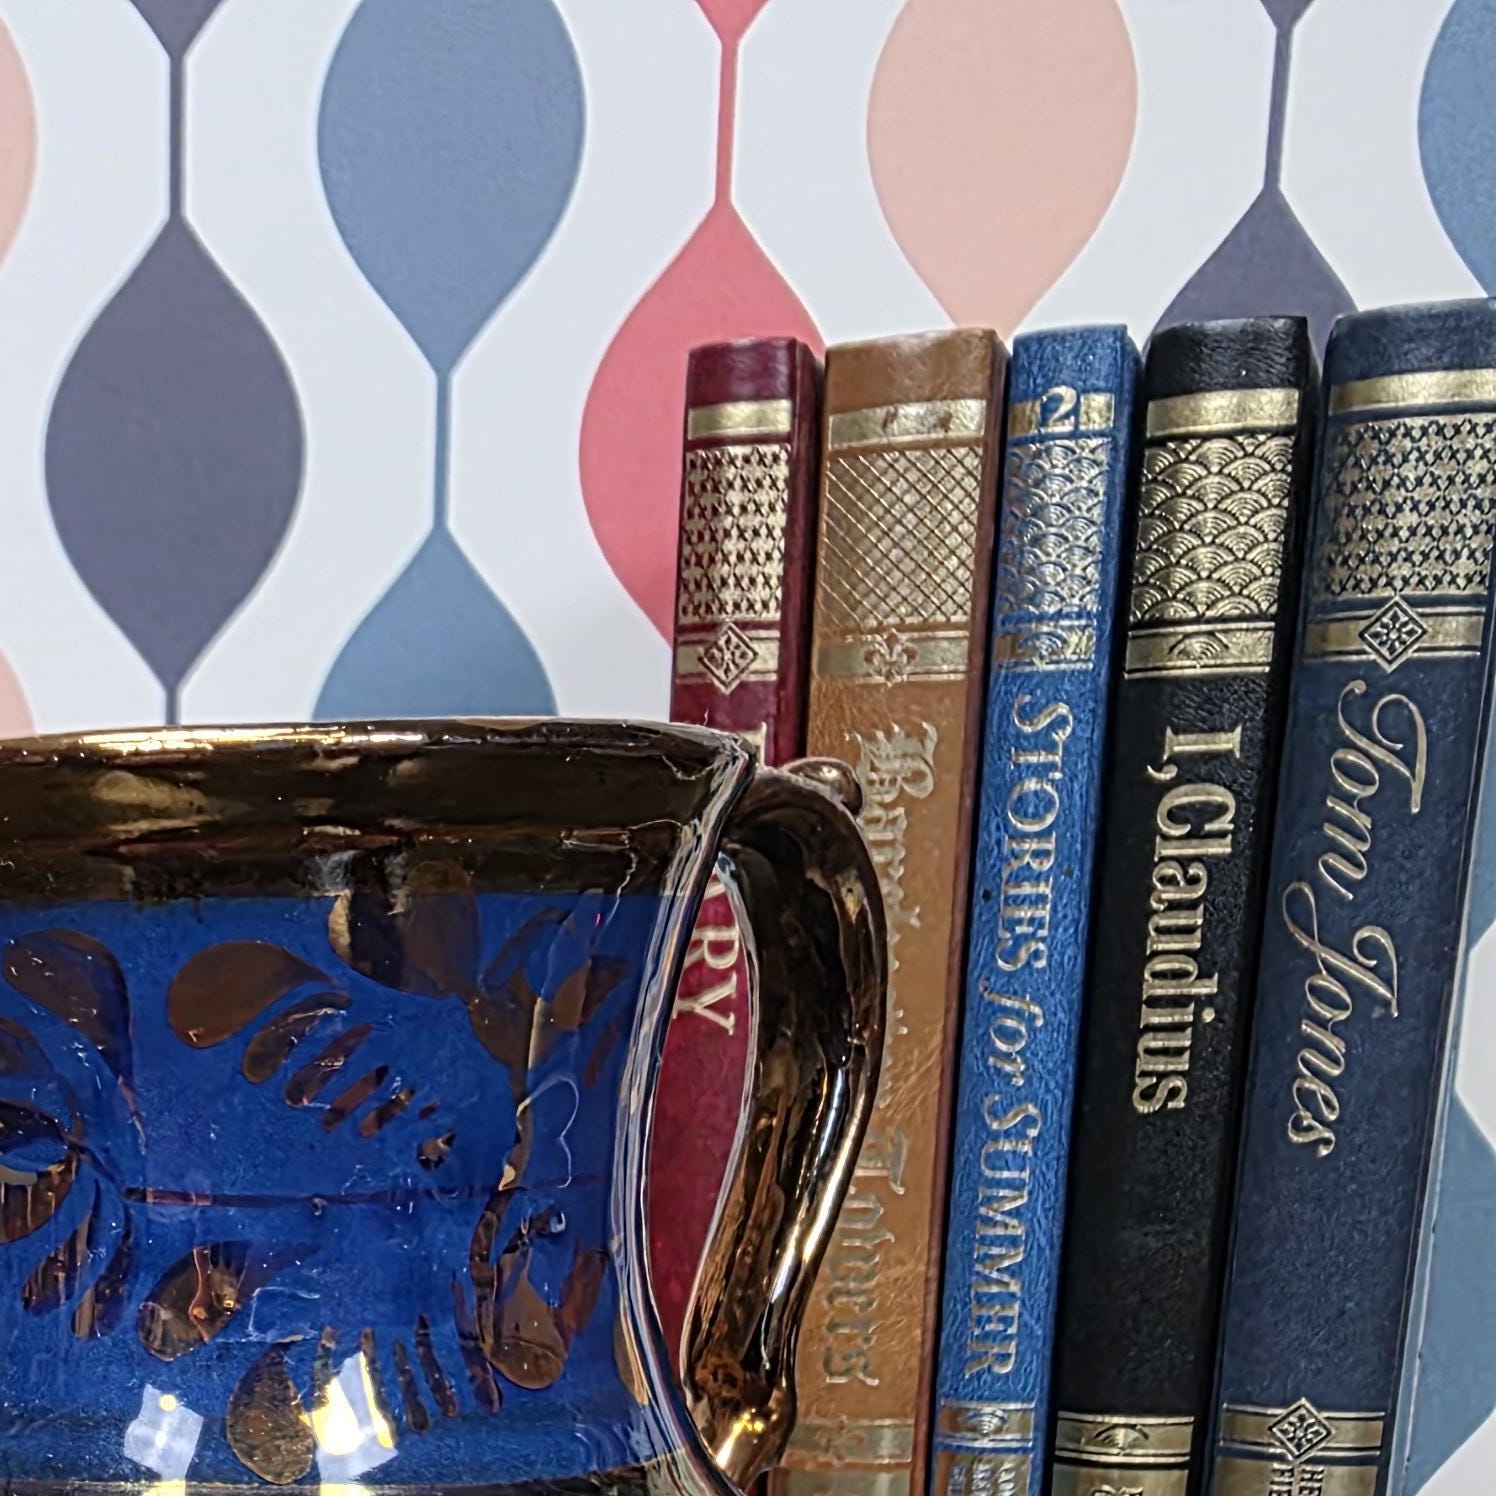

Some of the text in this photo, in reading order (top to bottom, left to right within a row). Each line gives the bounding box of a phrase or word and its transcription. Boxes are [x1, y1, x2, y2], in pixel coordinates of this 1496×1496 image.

[1033, 385, 1078, 434] 2
[964, 695, 1073, 1378] STORIES for SUMMER
[1283, 680, 1427, 1158] Tom Jones
